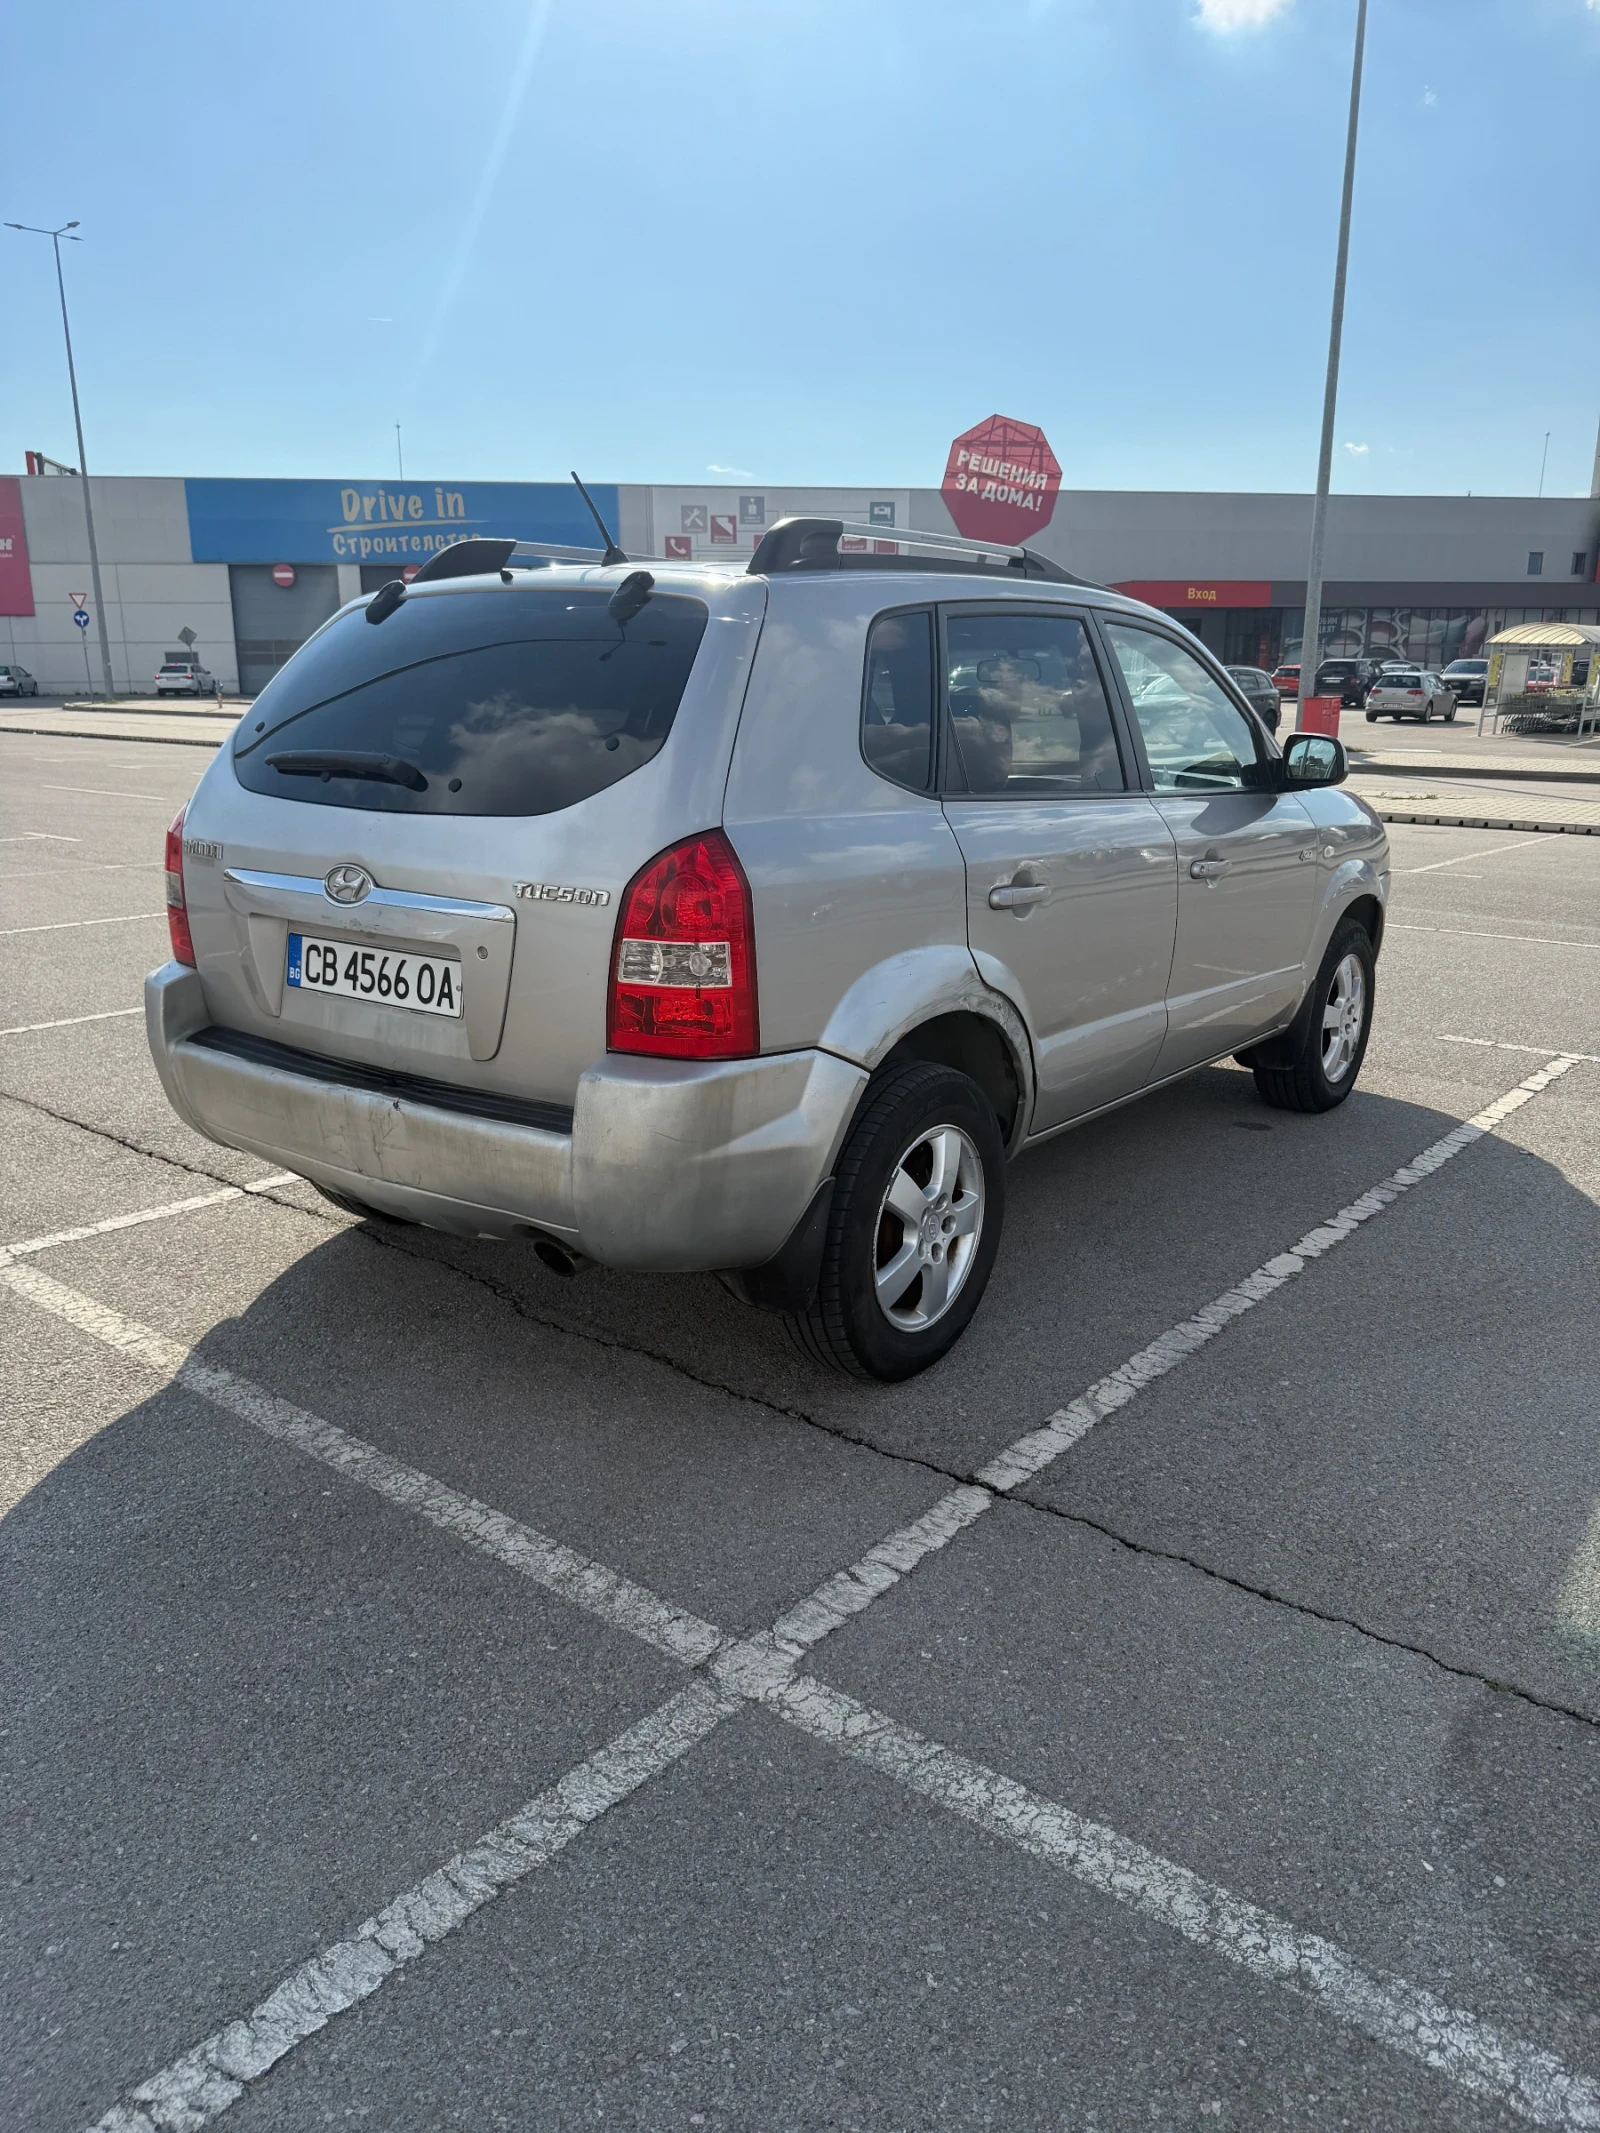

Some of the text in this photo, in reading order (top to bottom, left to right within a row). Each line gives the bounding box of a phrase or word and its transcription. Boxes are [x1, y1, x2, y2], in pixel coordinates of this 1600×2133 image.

[957, 449, 1048, 490] РЕШЕНИЯ
[340, 487, 465, 522] Drive in
[955, 473, 1044, 512] ЗА ДОМА!
[1187, 587, 1217, 601] Вход
[513, 882, 611, 906] TUCSON
[289, 966, 301, 980] BG
[305, 944, 455, 1010] CB 4566 OA
